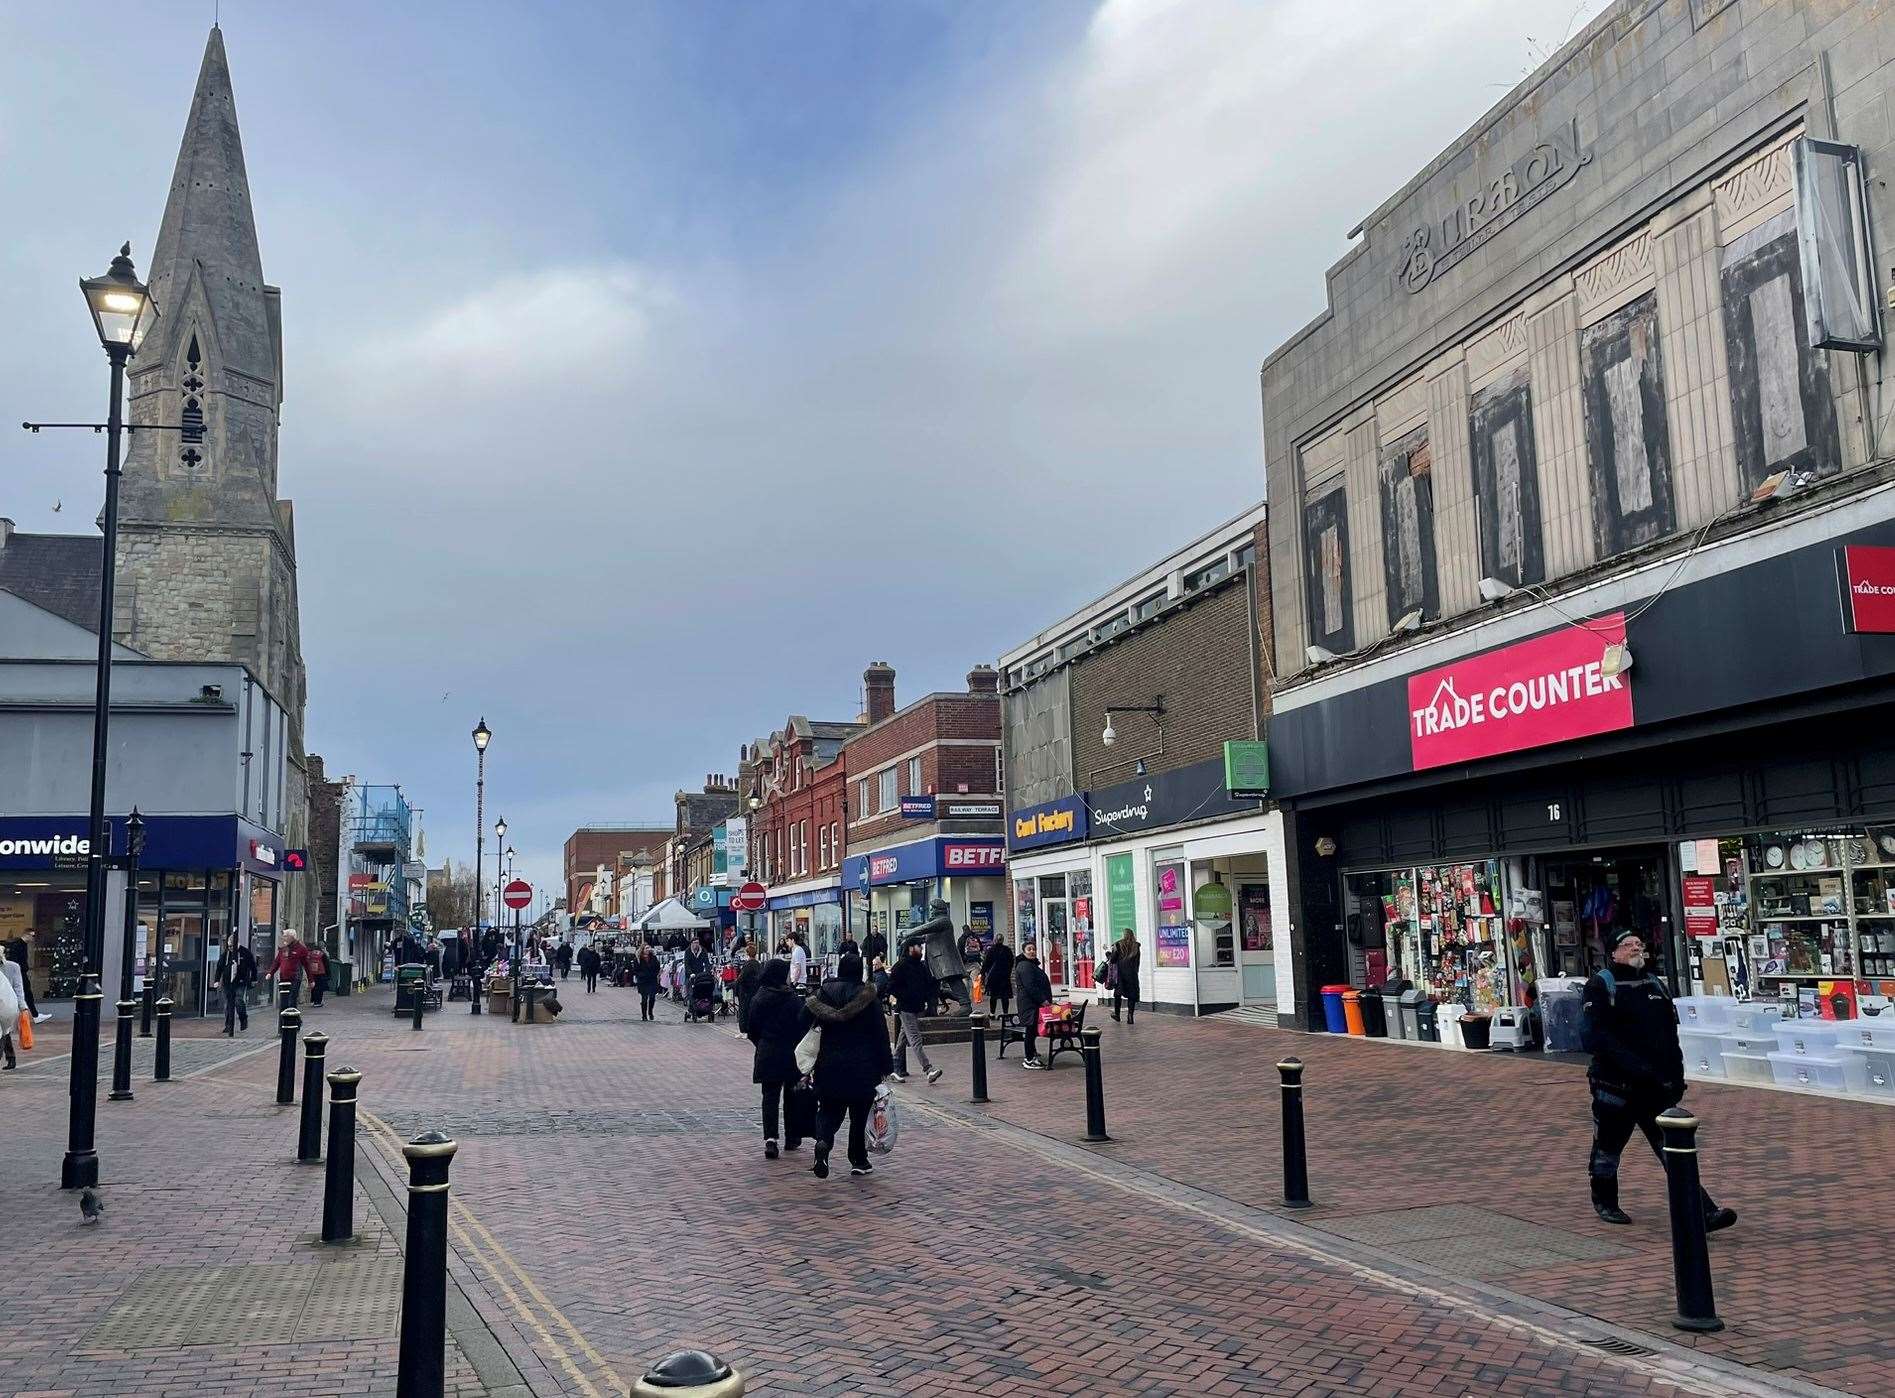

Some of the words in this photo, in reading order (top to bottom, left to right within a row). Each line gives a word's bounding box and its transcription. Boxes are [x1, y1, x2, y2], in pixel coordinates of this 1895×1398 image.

[1853, 581, 1879, 594] TRADE
[1412, 690, 1485, 737] TRADE
[1095, 804, 1148, 825] Superdrug
[1547, 804, 1560, 821] 16
[872, 857, 898, 876] BETFRED
